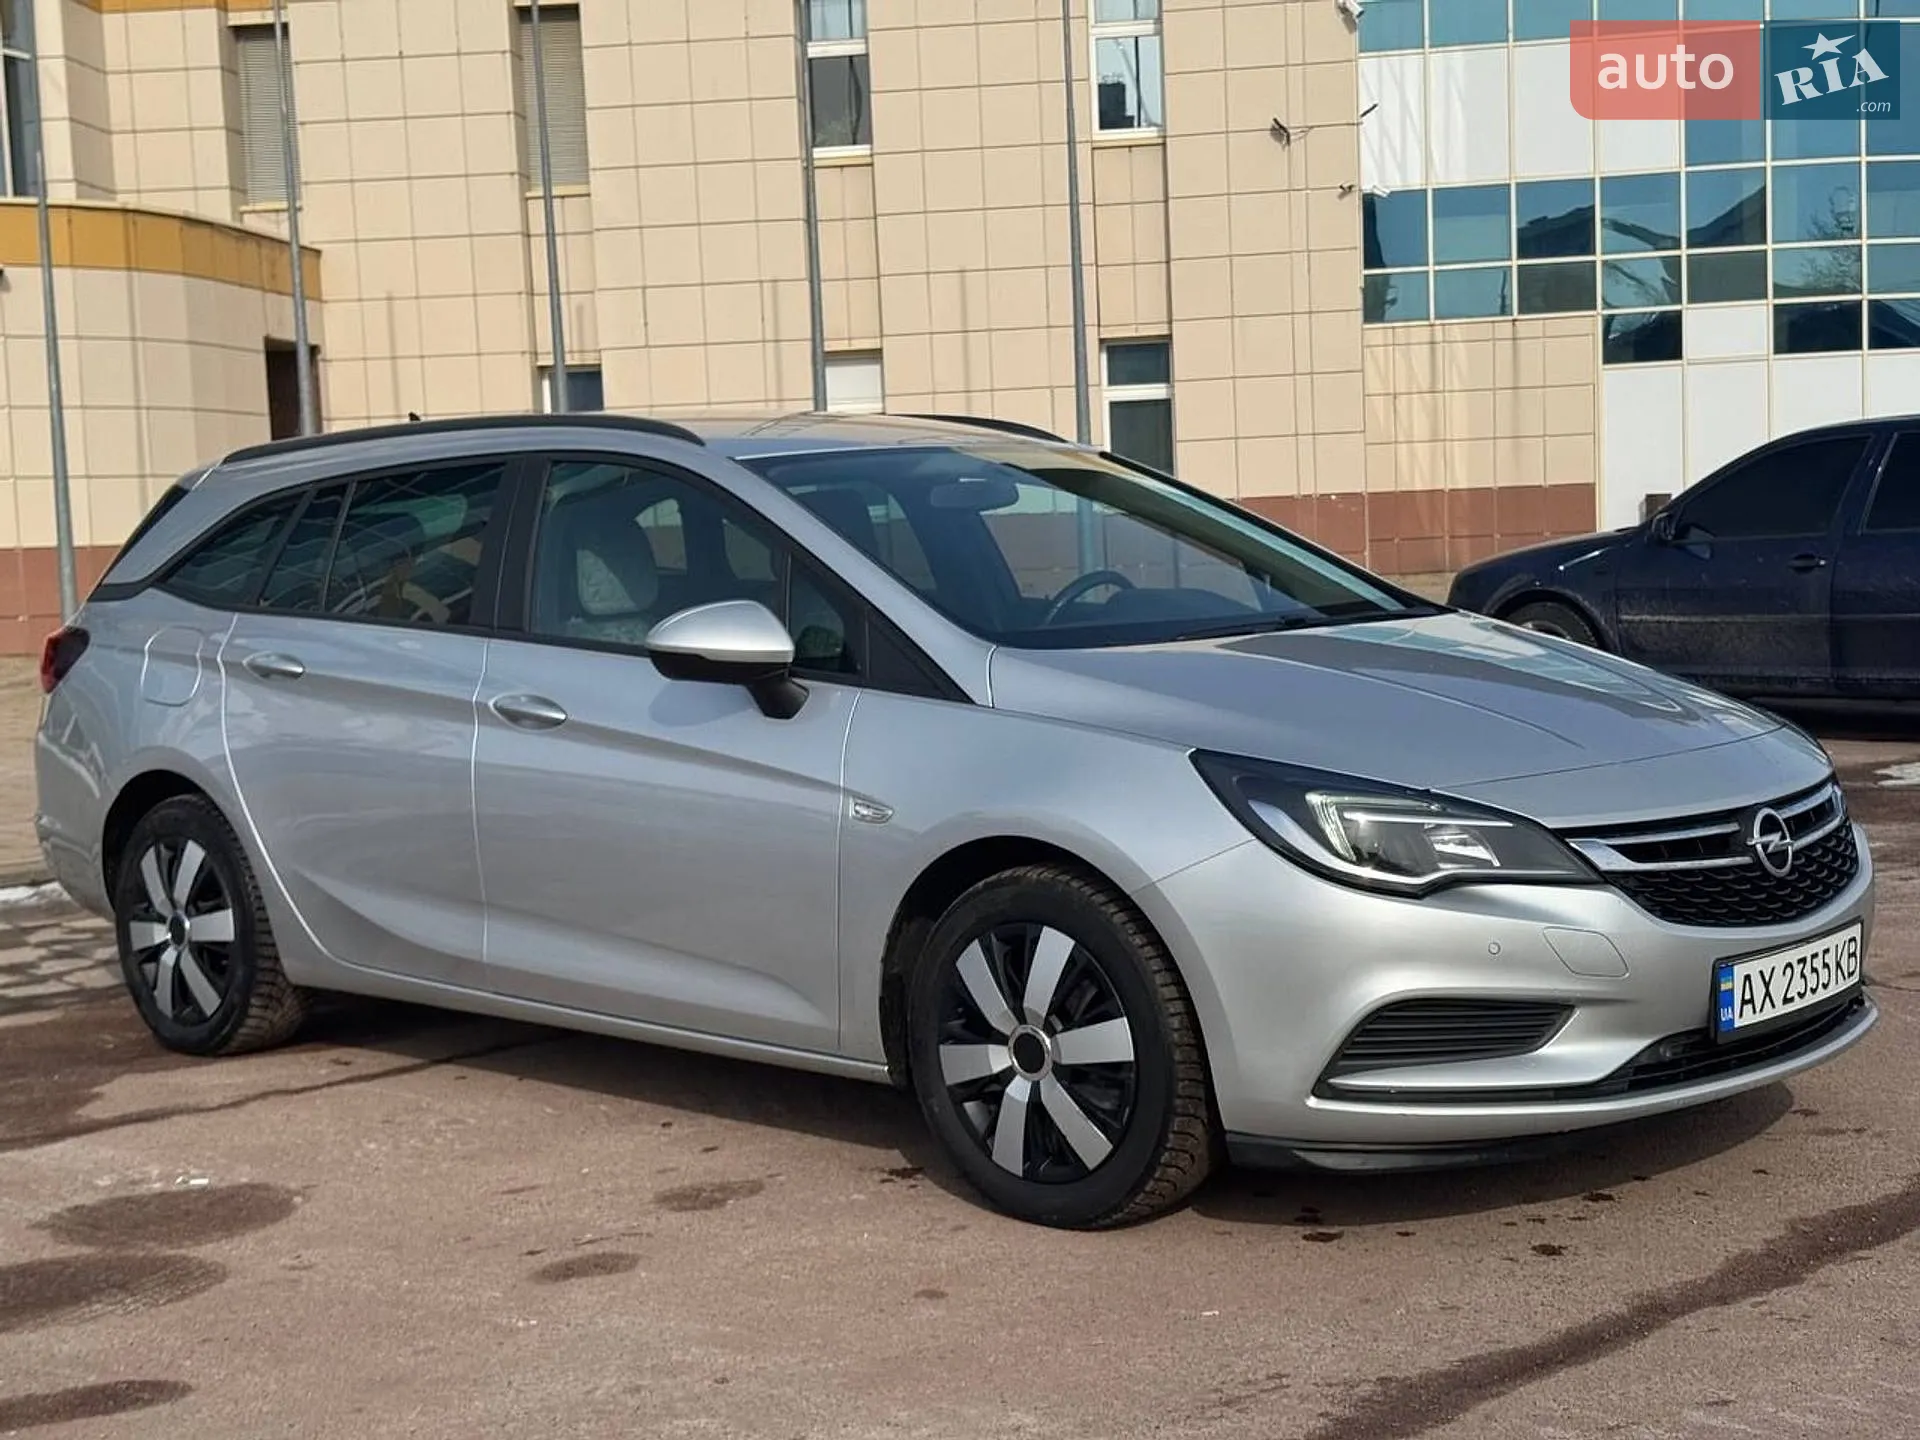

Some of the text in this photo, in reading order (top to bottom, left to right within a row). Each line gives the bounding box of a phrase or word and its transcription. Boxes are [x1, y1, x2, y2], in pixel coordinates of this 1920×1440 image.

[1739, 936, 1858, 1019] AX 2355 KB
[1720, 1006, 1733, 1022] UA
